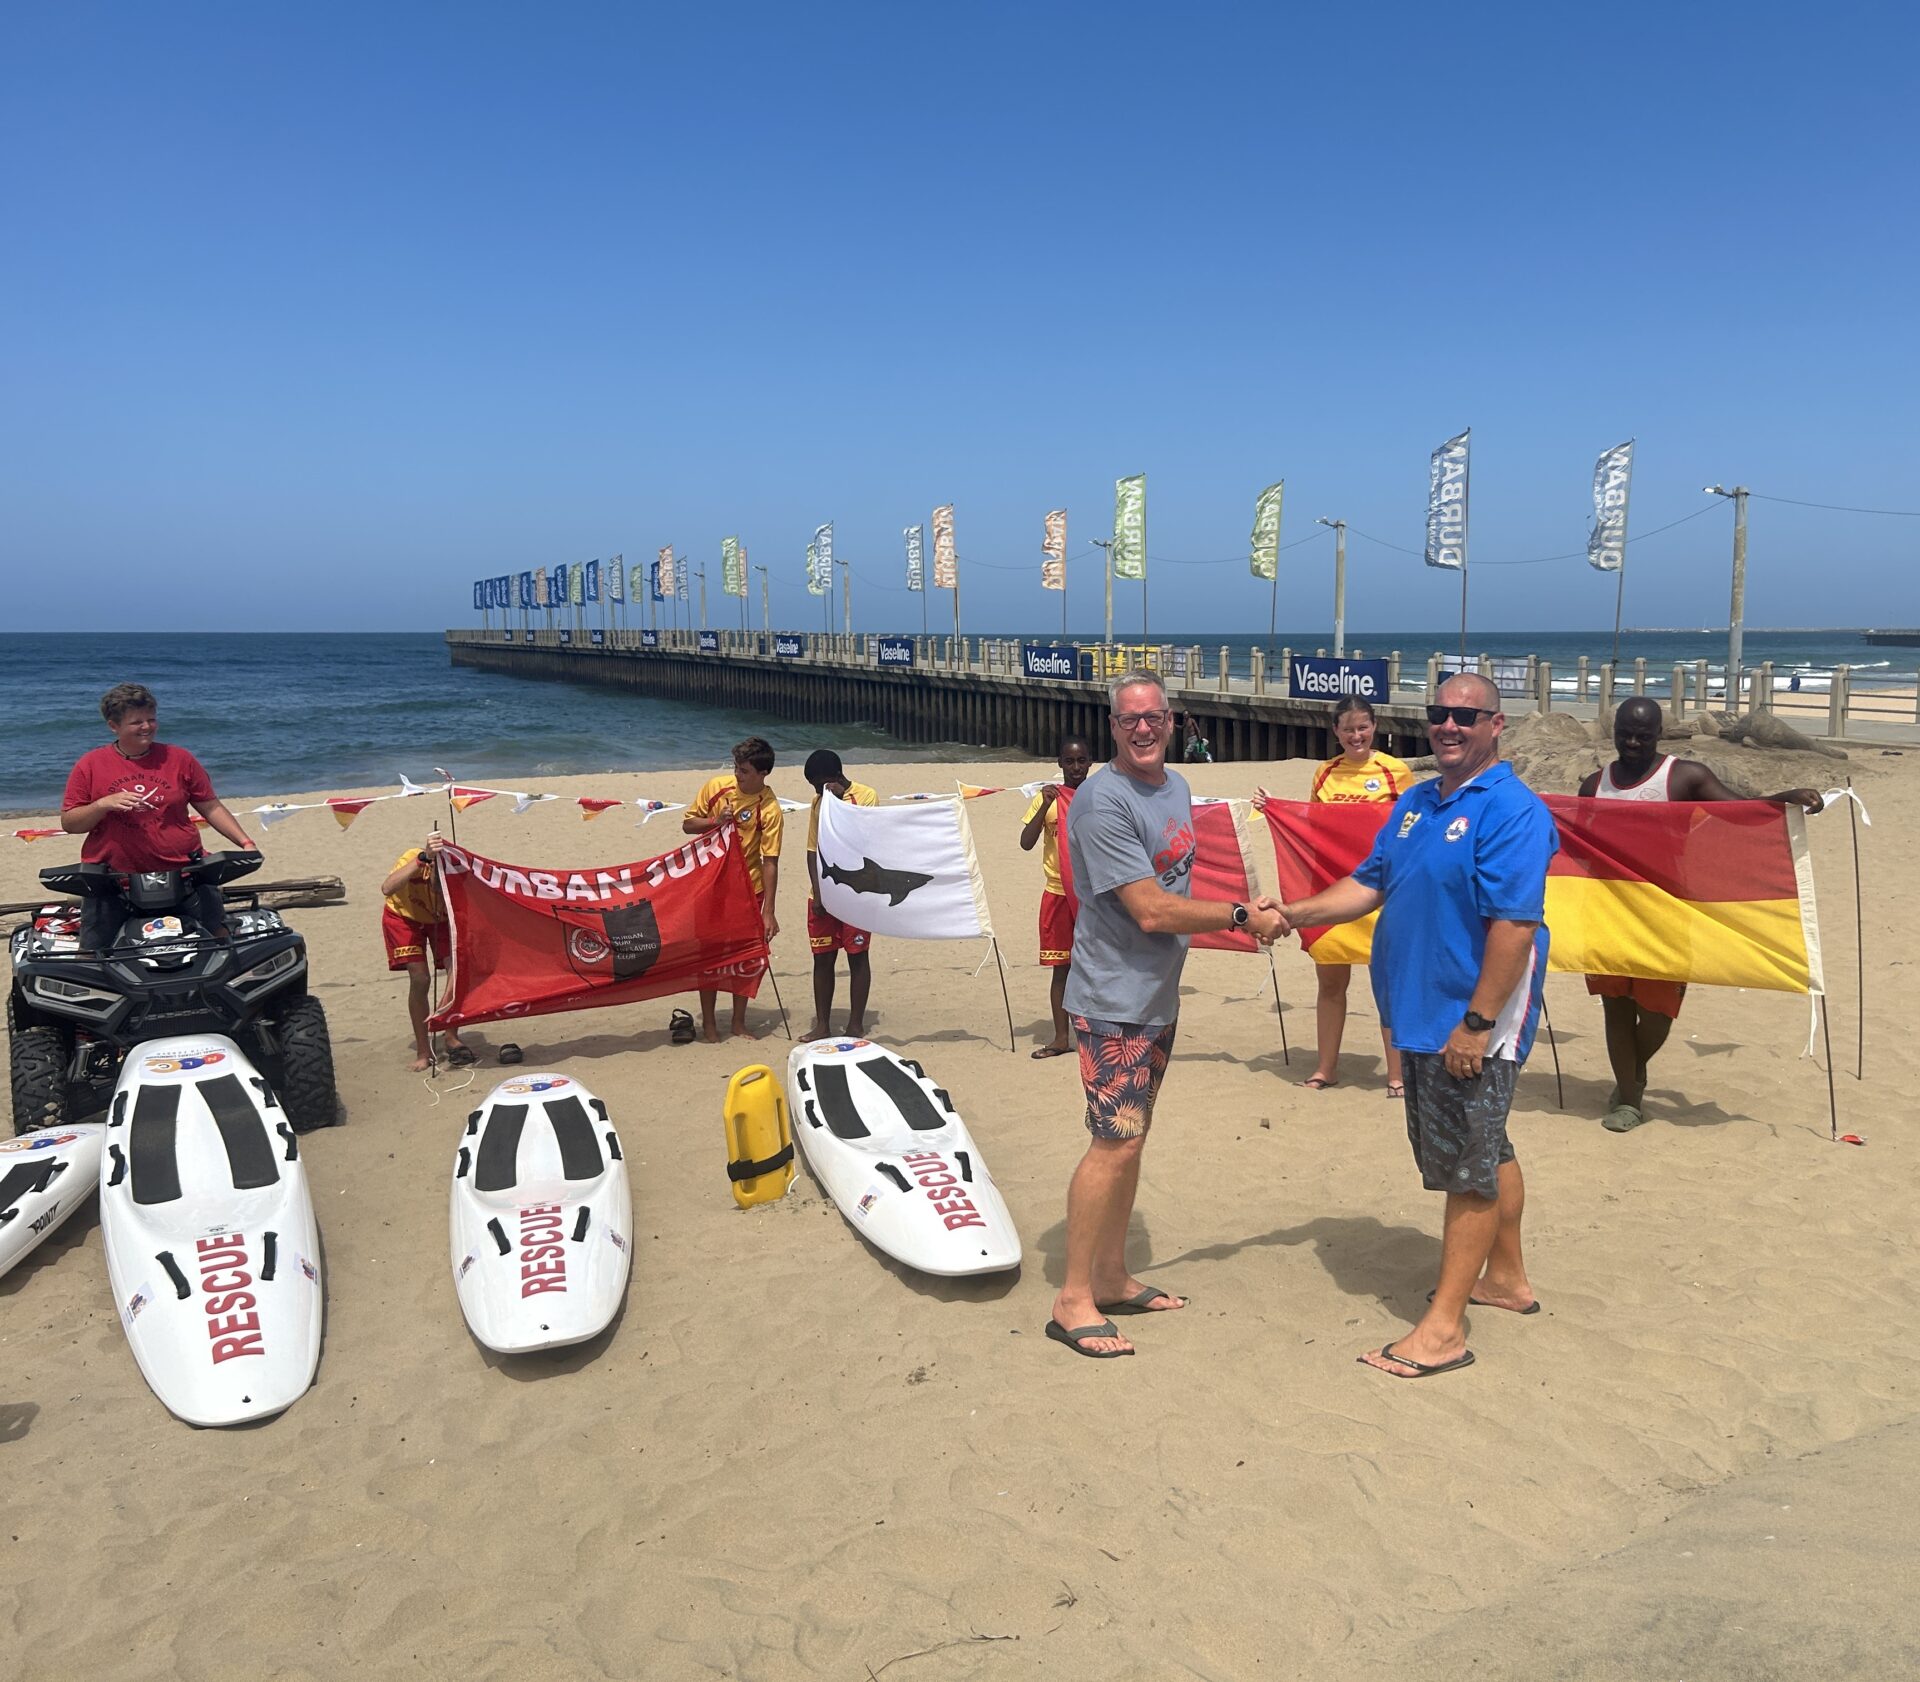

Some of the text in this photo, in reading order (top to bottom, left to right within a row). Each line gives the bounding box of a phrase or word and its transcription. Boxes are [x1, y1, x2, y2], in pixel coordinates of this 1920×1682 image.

[776, 638, 799, 655] Vaseline
[879, 643, 911, 662] Vaseline
[1026, 650, 1071, 675] Vaseline
[1294, 663, 1374, 697] Vaseline
[441, 845, 635, 901] DURBAN
[902, 1151, 987, 1231] RESCUE
[520, 1205, 567, 1299] RESCUE
[196, 1233, 266, 1364] RESCUE
